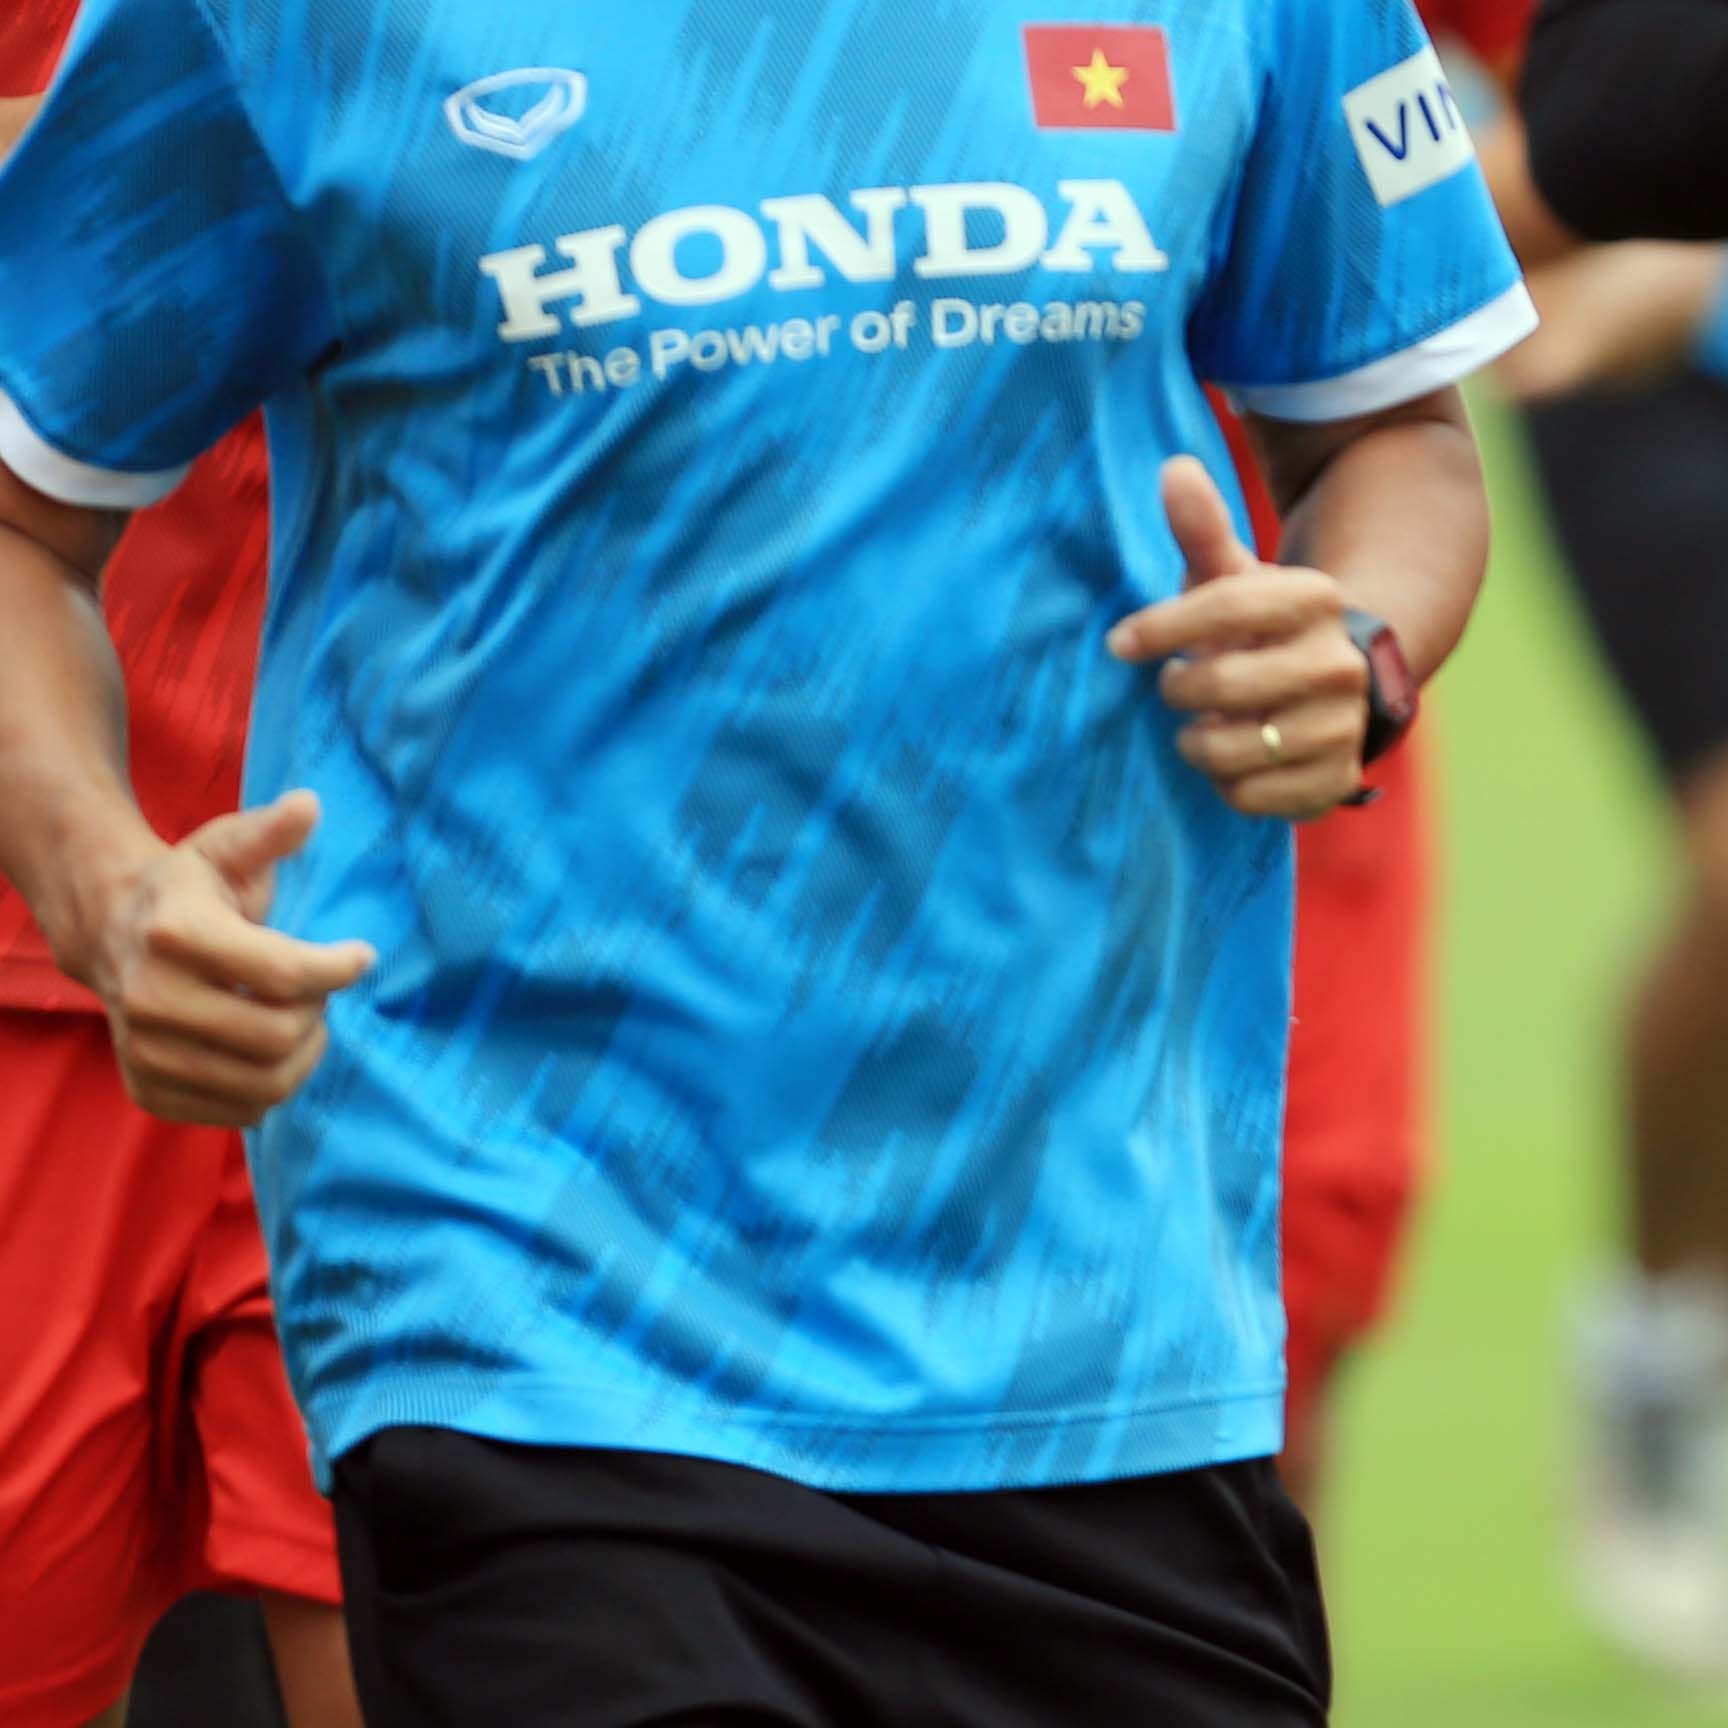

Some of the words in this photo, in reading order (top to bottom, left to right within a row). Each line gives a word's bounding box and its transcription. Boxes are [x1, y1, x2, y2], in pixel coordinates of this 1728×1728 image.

[479, 179, 1168, 342] HONDA
[528, 346, 641, 396] The
[650, 314, 840, 380] Power
[850, 299, 916, 353] of
[931, 297, 1147, 348] Dreams
